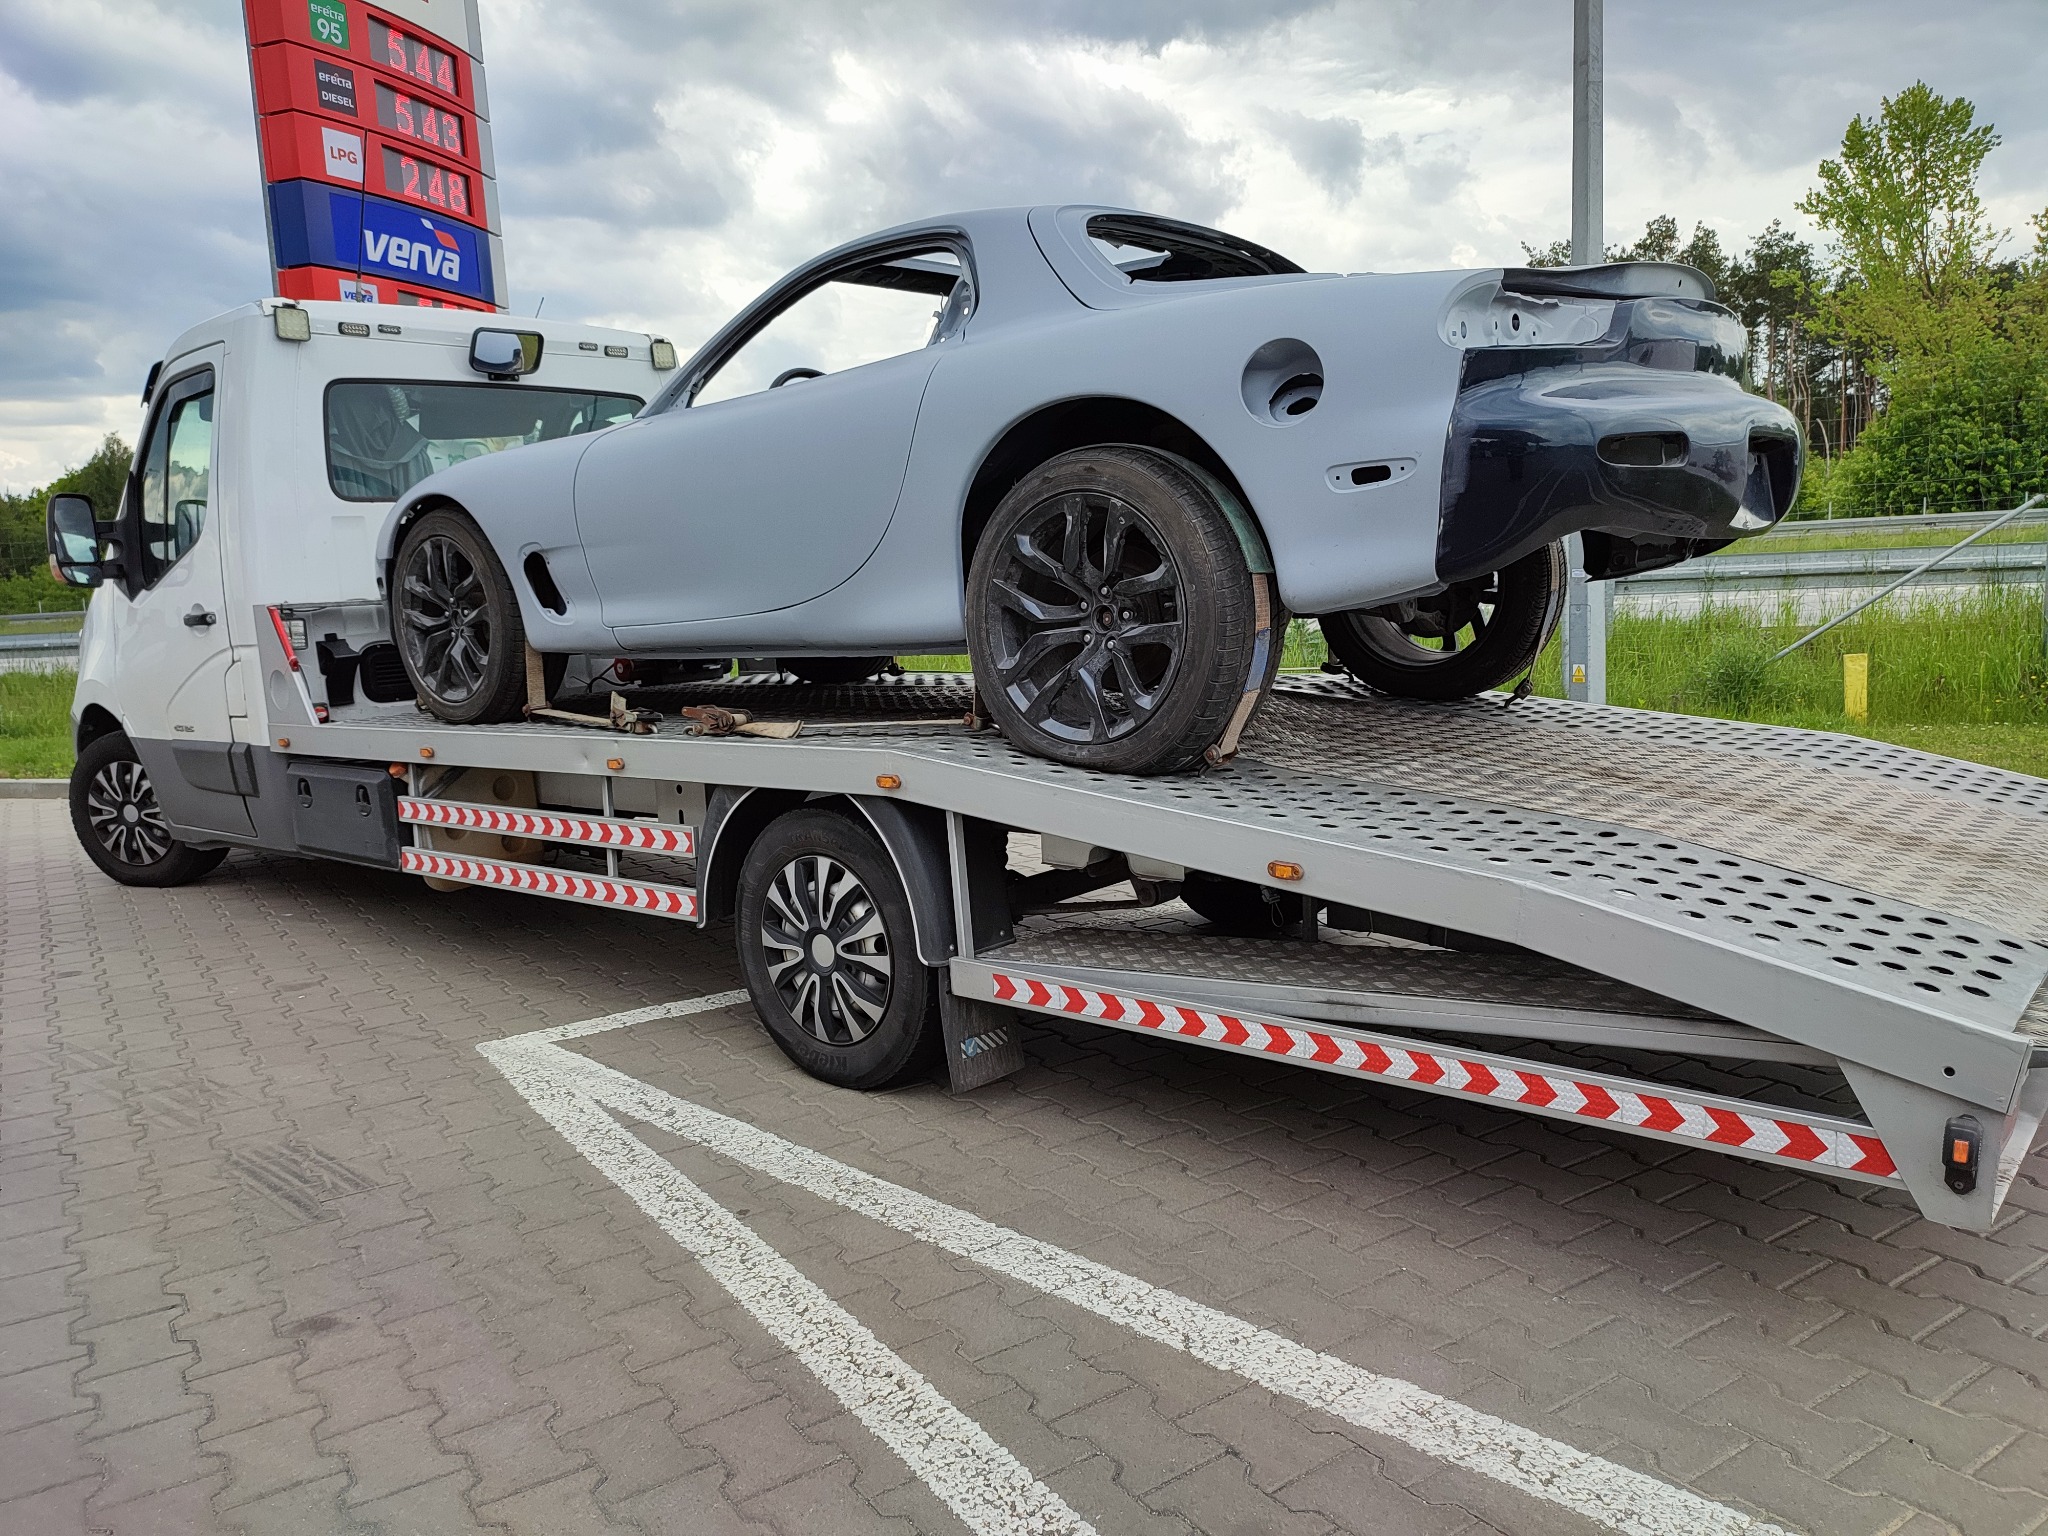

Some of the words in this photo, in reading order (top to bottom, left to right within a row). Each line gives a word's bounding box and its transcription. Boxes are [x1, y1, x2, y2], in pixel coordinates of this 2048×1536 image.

[316, 18, 343, 44] 95
[387, 28, 454, 92] 5.44
[321, 91, 355, 109] DIESEL
[395, 94, 461, 154] 5.43
[329, 145, 359, 165] LPG
[400, 156, 467, 214] 2.48
[363, 229, 461, 282] verva
[343, 290, 374, 303] veva
